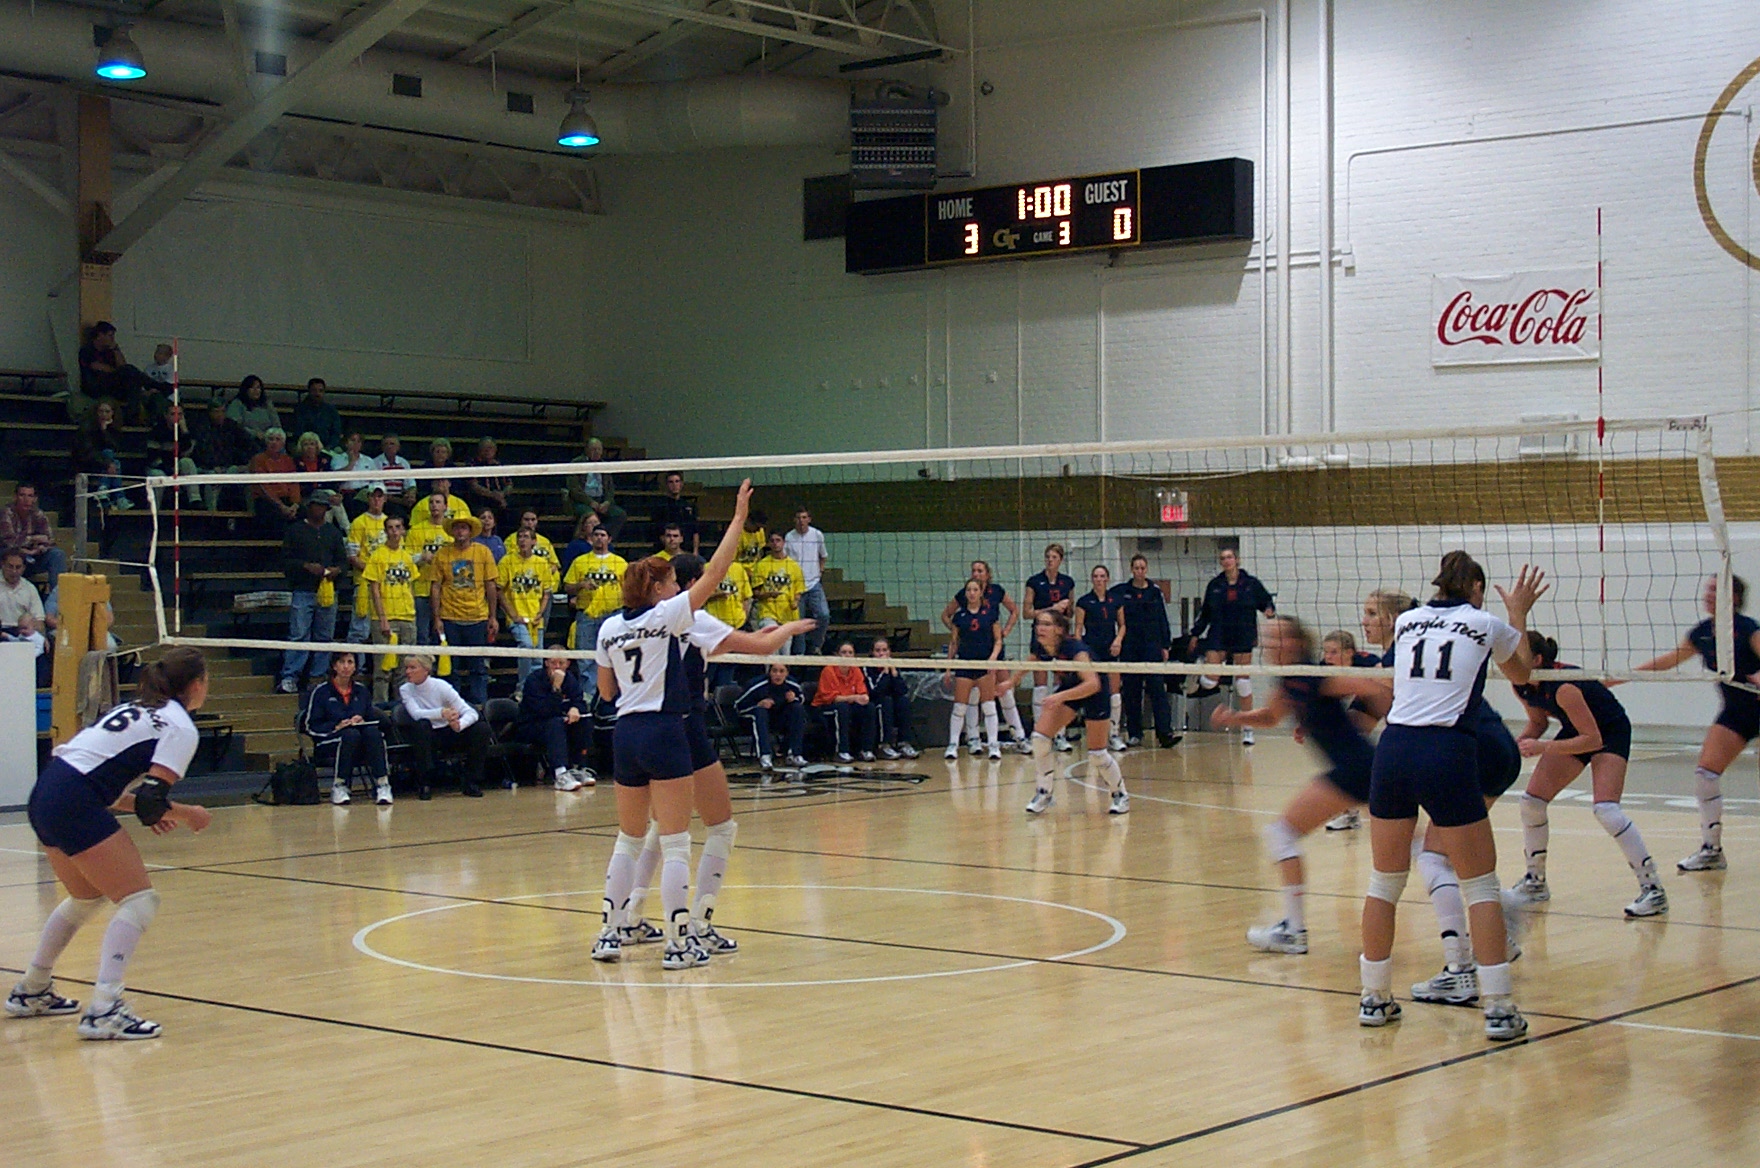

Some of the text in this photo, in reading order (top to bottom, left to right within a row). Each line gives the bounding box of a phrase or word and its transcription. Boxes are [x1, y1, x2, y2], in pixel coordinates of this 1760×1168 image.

[1018, 184, 1071, 220] 1:00
[1085, 180, 1128, 204] GUEST
[938, 197, 974, 221] HOME
[1033, 220, 1071, 245] GAME 3
[1113, 207, 1131, 240] 0
[964, 223, 979, 254] 3
[637, 625, 668, 639] Tech
[1451, 621, 1487, 646] Tech
[624, 647, 644, 683] 7
[1410, 639, 1454, 680] 11
[103, 707, 141, 732] 6
